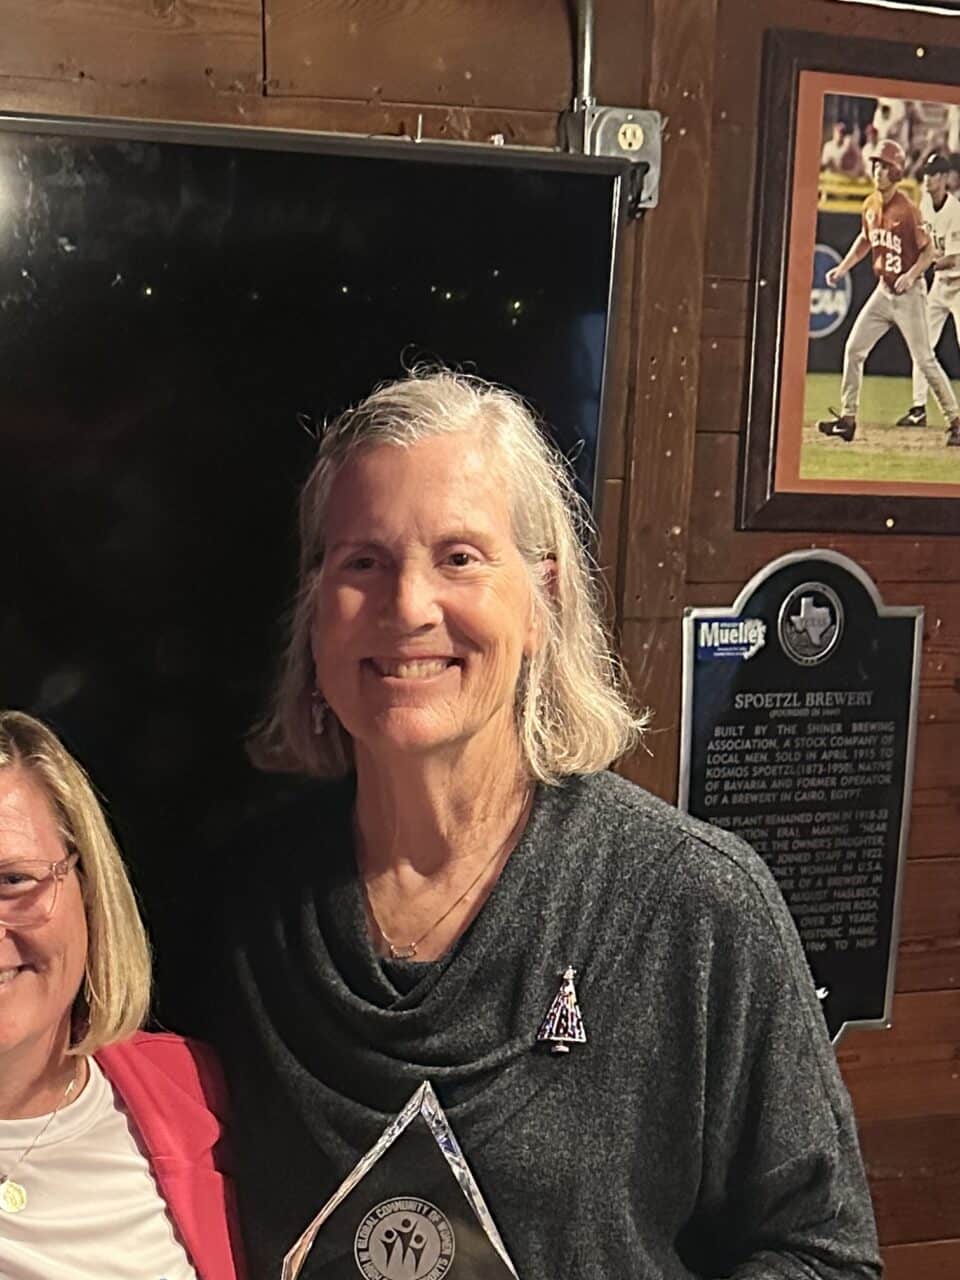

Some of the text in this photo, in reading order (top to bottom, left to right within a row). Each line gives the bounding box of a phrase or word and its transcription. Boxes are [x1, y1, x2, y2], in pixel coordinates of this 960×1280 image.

[885, 252, 902, 274] 23
[734, 691, 873, 709] SPOETZL BREWERY
[714, 721, 895, 737] BUILT BY THE SHINER BREWING
[783, 738, 791, 748] A
[794, 737, 827, 749] STOCK
[829, 735, 879, 747] COMPANY
[881, 734, 893, 745] OF
[707, 753, 740, 765] LOCAL
[775, 751, 801, 762] SOLD
[806, 750, 816, 761] IN
[821, 749, 848, 760] APRIL
[880, 747, 893, 758] TO
[705, 765, 749, 779] KOSMOS
[752, 764, 794, 776] SPOETZL
[705, 780, 719, 792] OF
[724, 779, 768, 791] BAVARIA
[771, 778, 792, 789] AND
[840, 774, 892, 786] OPERATOR
[704, 794, 718, 806] OF
[721, 794, 729, 804] A
